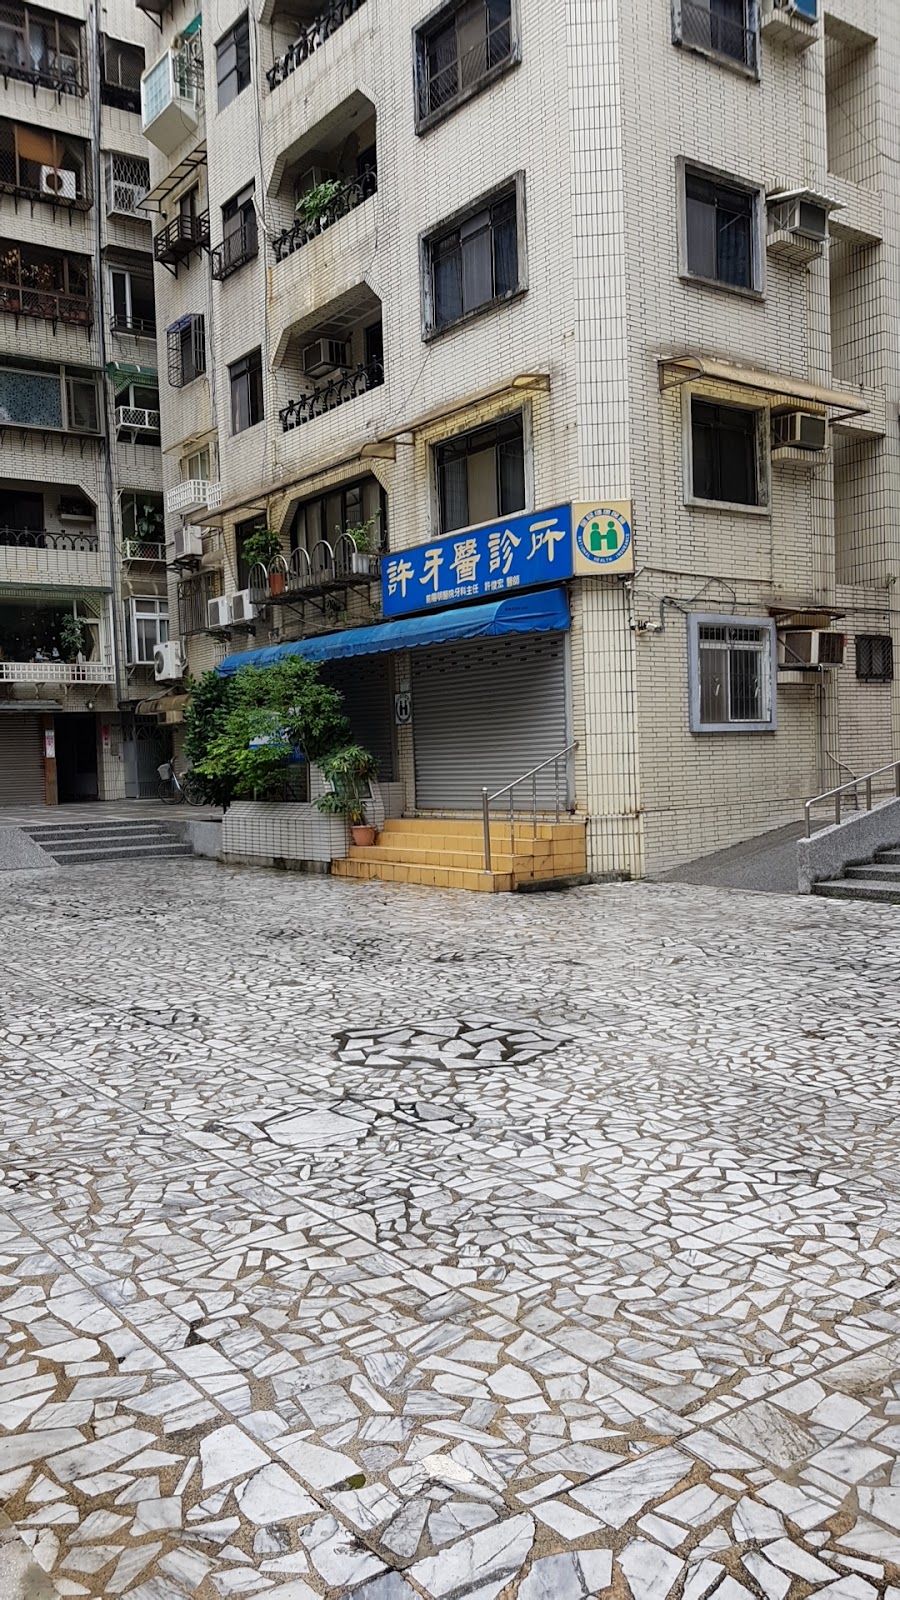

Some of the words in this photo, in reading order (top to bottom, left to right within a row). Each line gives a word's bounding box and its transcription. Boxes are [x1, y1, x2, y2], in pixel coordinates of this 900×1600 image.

[386, 518, 566, 598] 許牙醫診所
